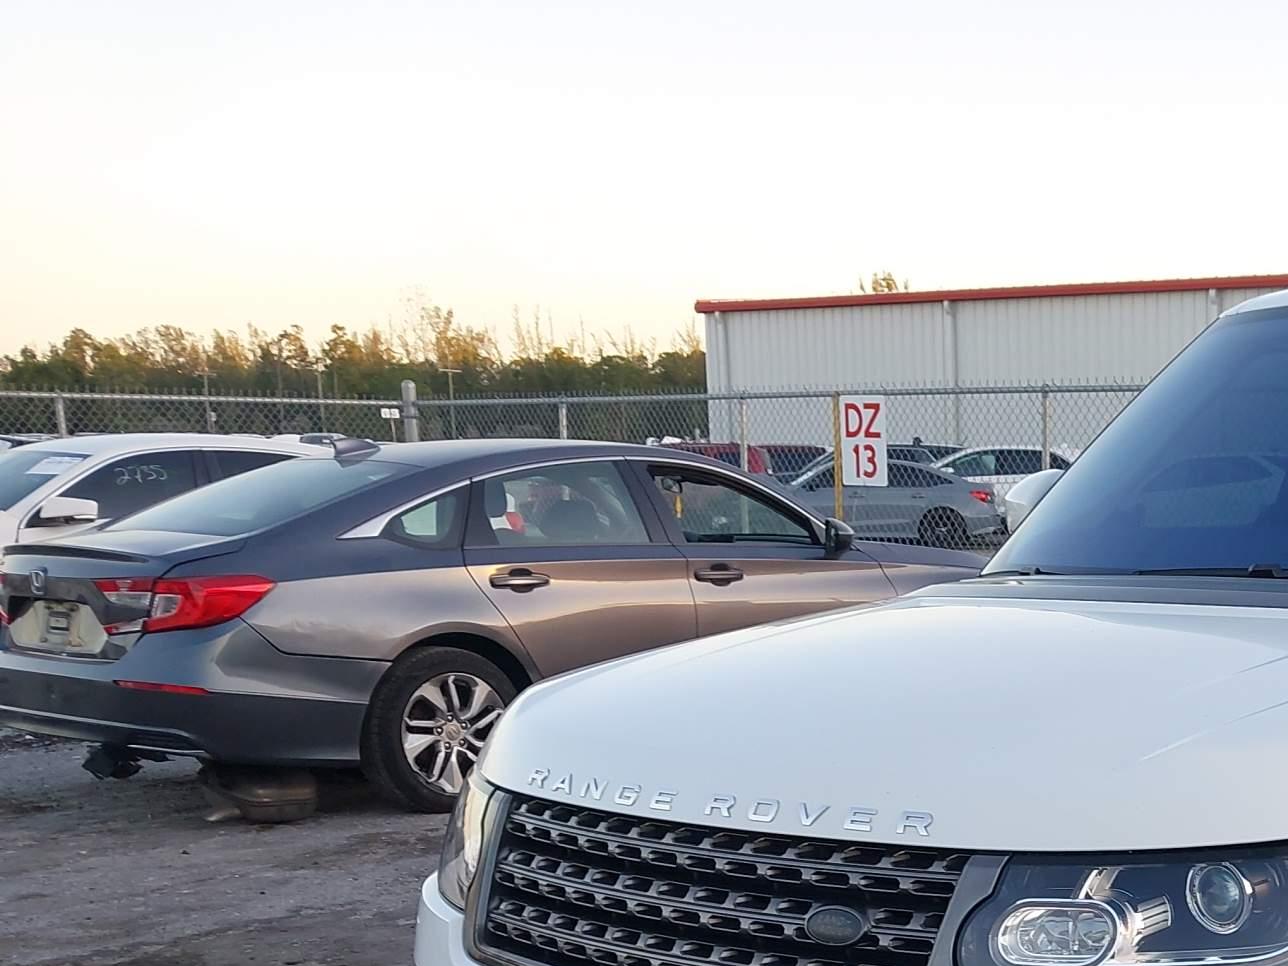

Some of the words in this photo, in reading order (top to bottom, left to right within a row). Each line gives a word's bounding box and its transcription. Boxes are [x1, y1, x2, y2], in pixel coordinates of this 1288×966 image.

[844, 402, 882, 439] DZ
[852, 443, 878, 479] 13
[527, 767, 679, 812] RANGE
[703, 792, 935, 837] ROVER
